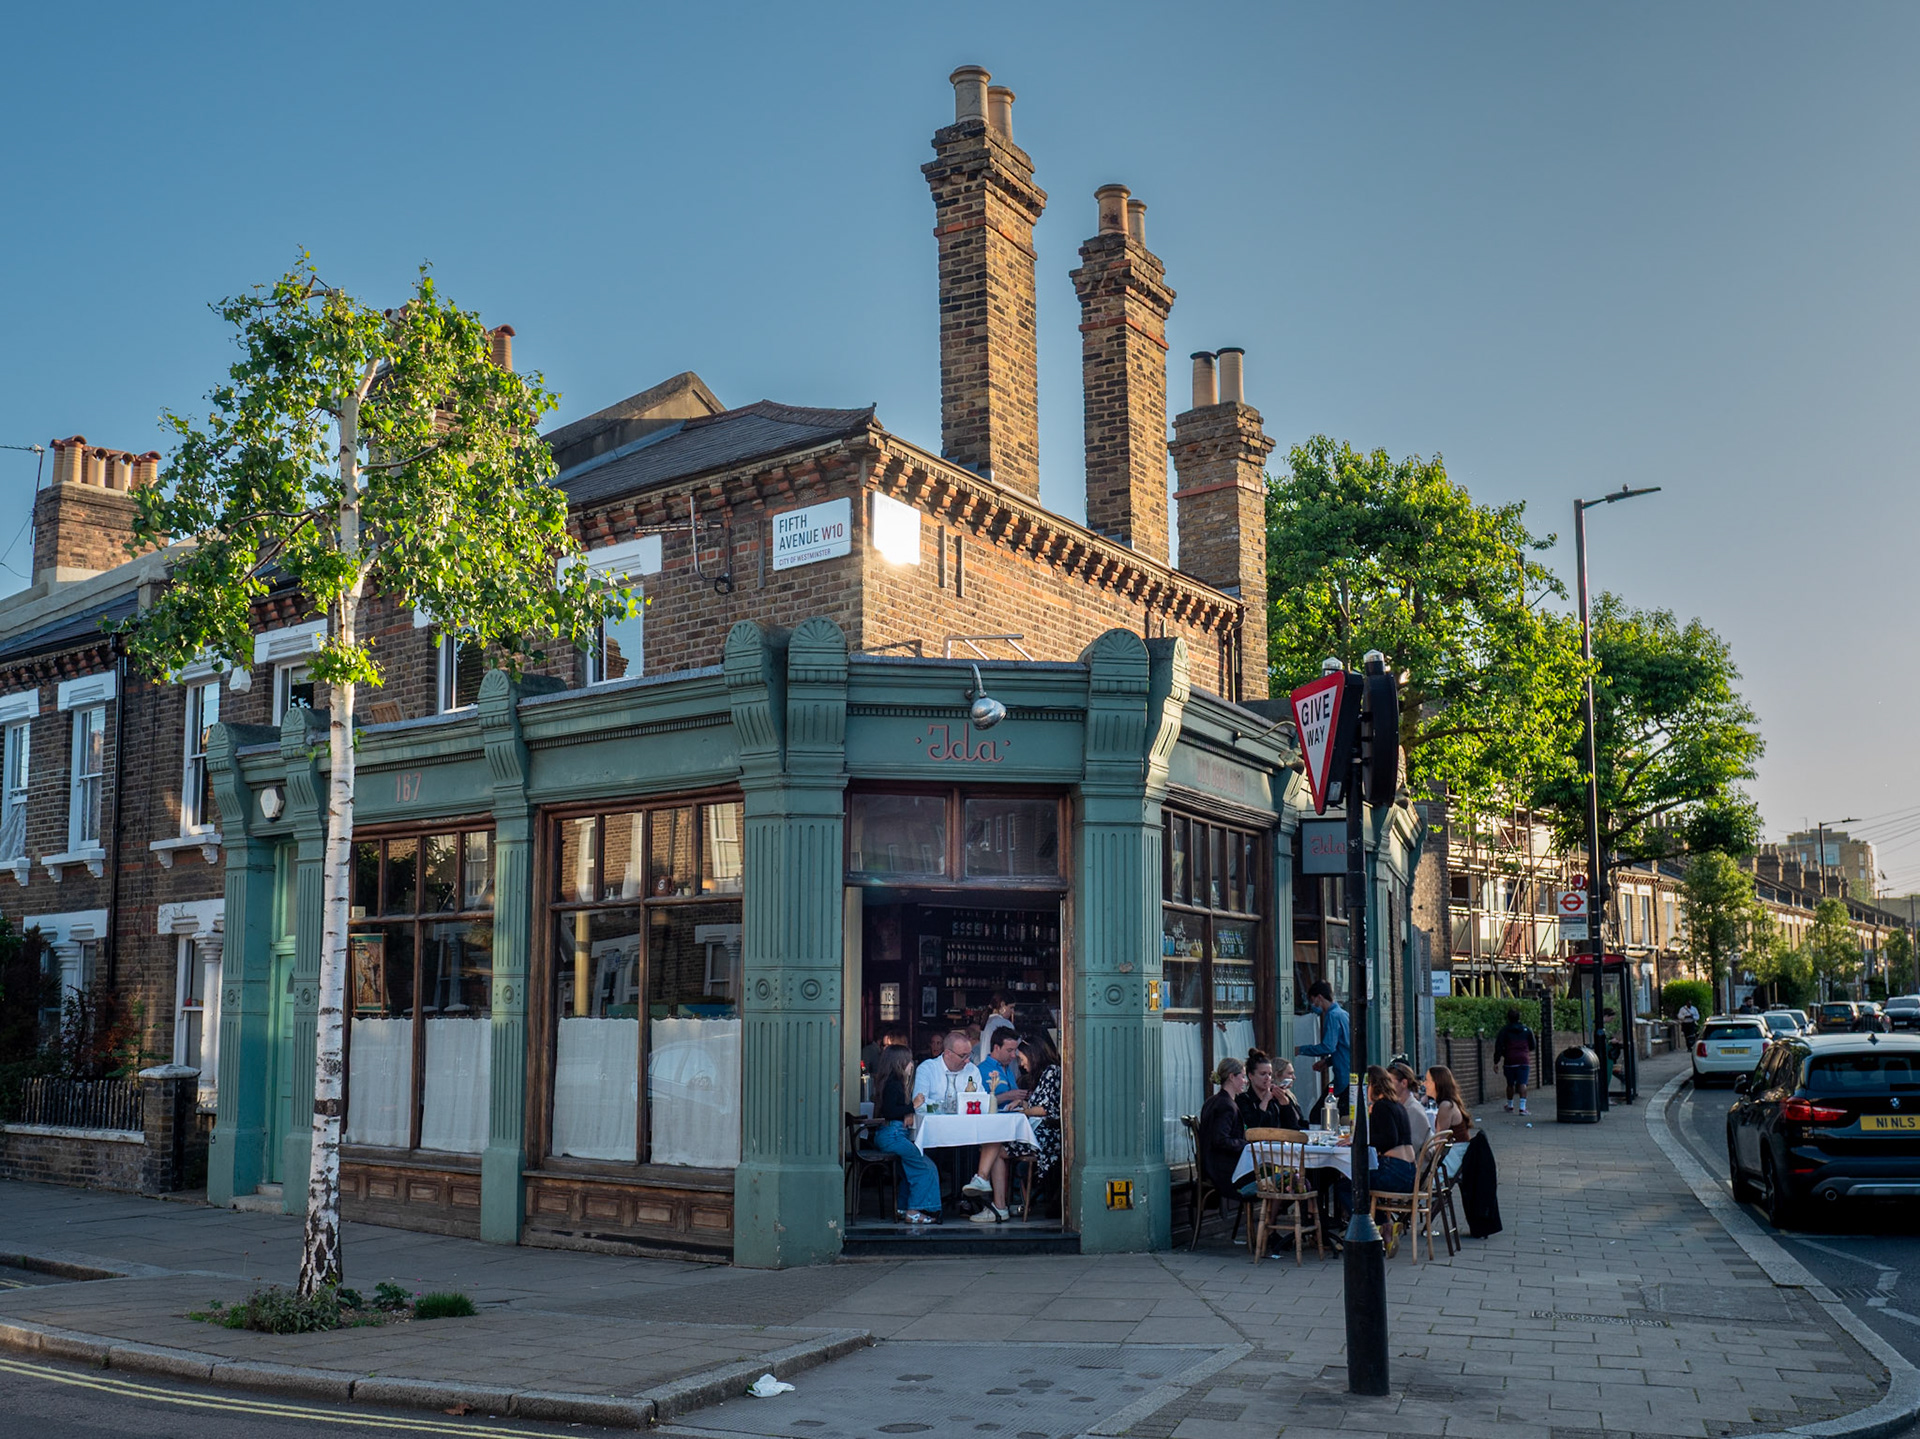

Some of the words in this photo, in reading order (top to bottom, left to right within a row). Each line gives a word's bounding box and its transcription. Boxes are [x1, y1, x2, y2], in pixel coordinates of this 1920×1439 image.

[779, 514, 807, 533] FIFTH
[779, 529, 819, 550] AVENUE
[822, 523, 843, 541] W10
[779, 557, 789, 566] CITY
[790, 555, 797, 563] OF
[797, 548, 832, 561] WESTMINSTER
[1301, 693, 1330, 726] GIVE
[1307, 725, 1325, 747] WAY
[396, 772, 422, 803] 167
[1576, 876, 1583, 887] J
[1890, 1117, 1916, 1128] NLS
